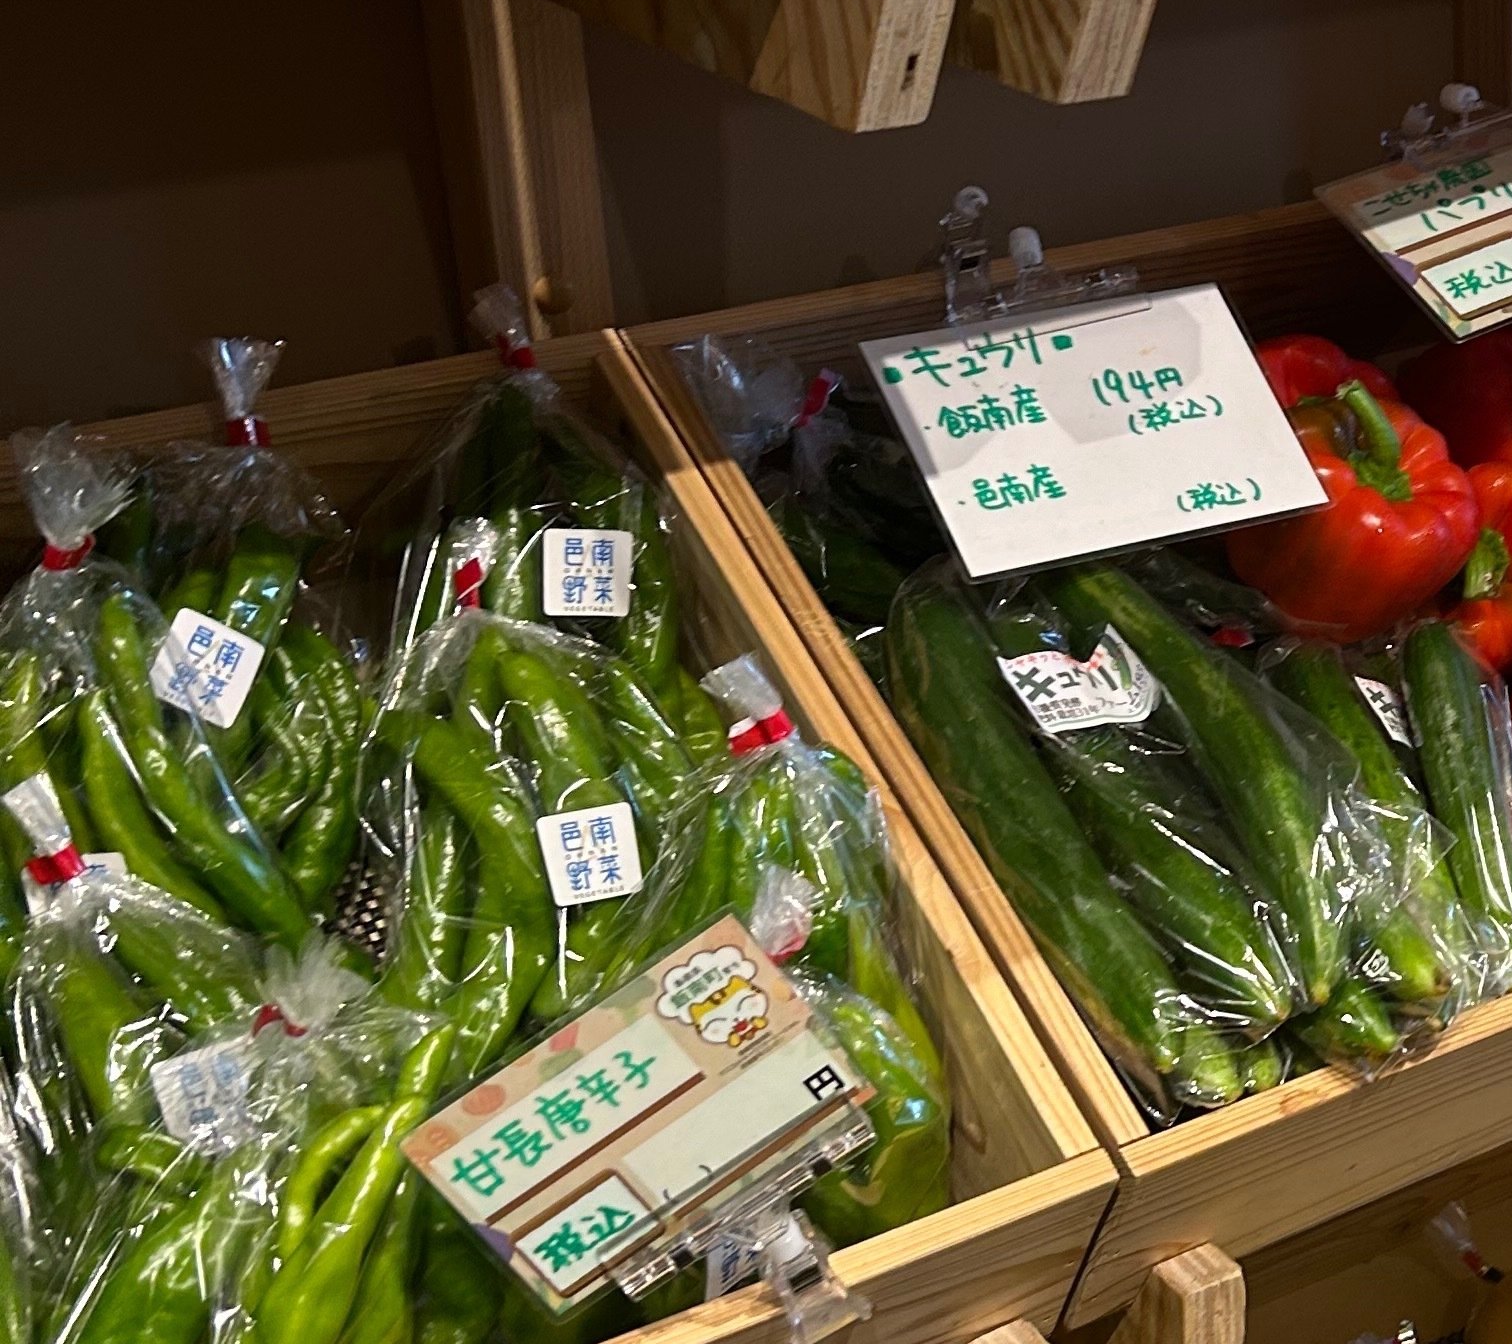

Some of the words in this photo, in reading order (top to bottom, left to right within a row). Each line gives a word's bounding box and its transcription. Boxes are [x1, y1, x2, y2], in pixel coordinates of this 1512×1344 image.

[903, 327, 1043, 387] キュウリ
[1092, 366, 1184, 407] 194円
[1127, 393, 1225, 436] (税込)
[1176, 478, 1264, 513] (税込)
[563, 538, 615, 567] 邑南
[562, 575, 613, 605] 野菜
[188, 624, 246, 674] 邑南
[560, 815, 617, 852] 邑南
[566, 854, 623, 891] 野菜
[802, 1063, 846, 1101] 円
[449, 1050, 658, 1197] 甘長唐辛子
[532, 1204, 637, 1274] 税込
